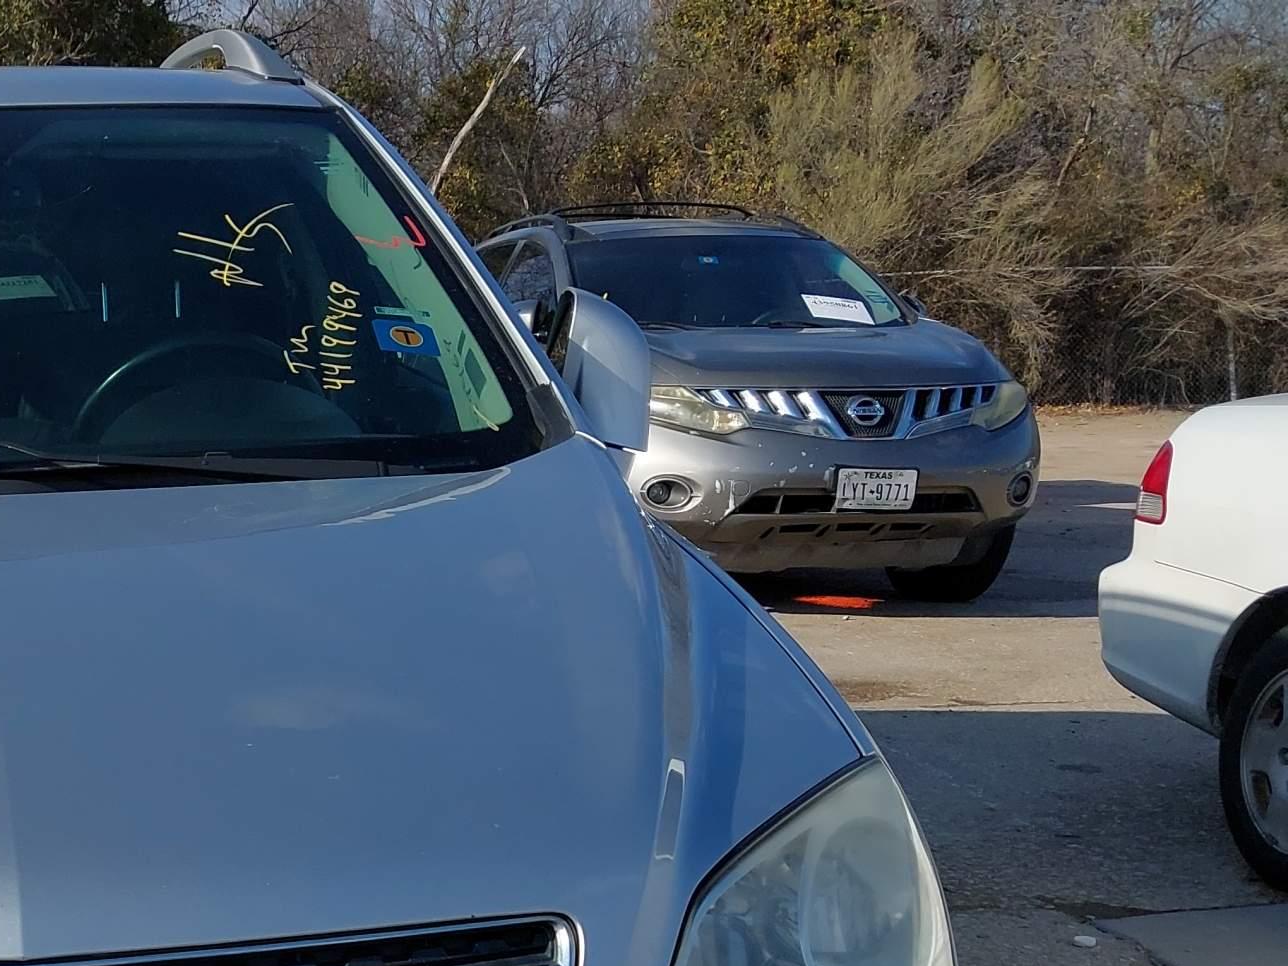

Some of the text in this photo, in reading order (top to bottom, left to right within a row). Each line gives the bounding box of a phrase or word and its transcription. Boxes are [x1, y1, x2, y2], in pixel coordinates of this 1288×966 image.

[319, 281, 363, 390] 44199469
[851, 407, 883, 415] NISSAN
[864, 471, 893, 479] TEXAS
